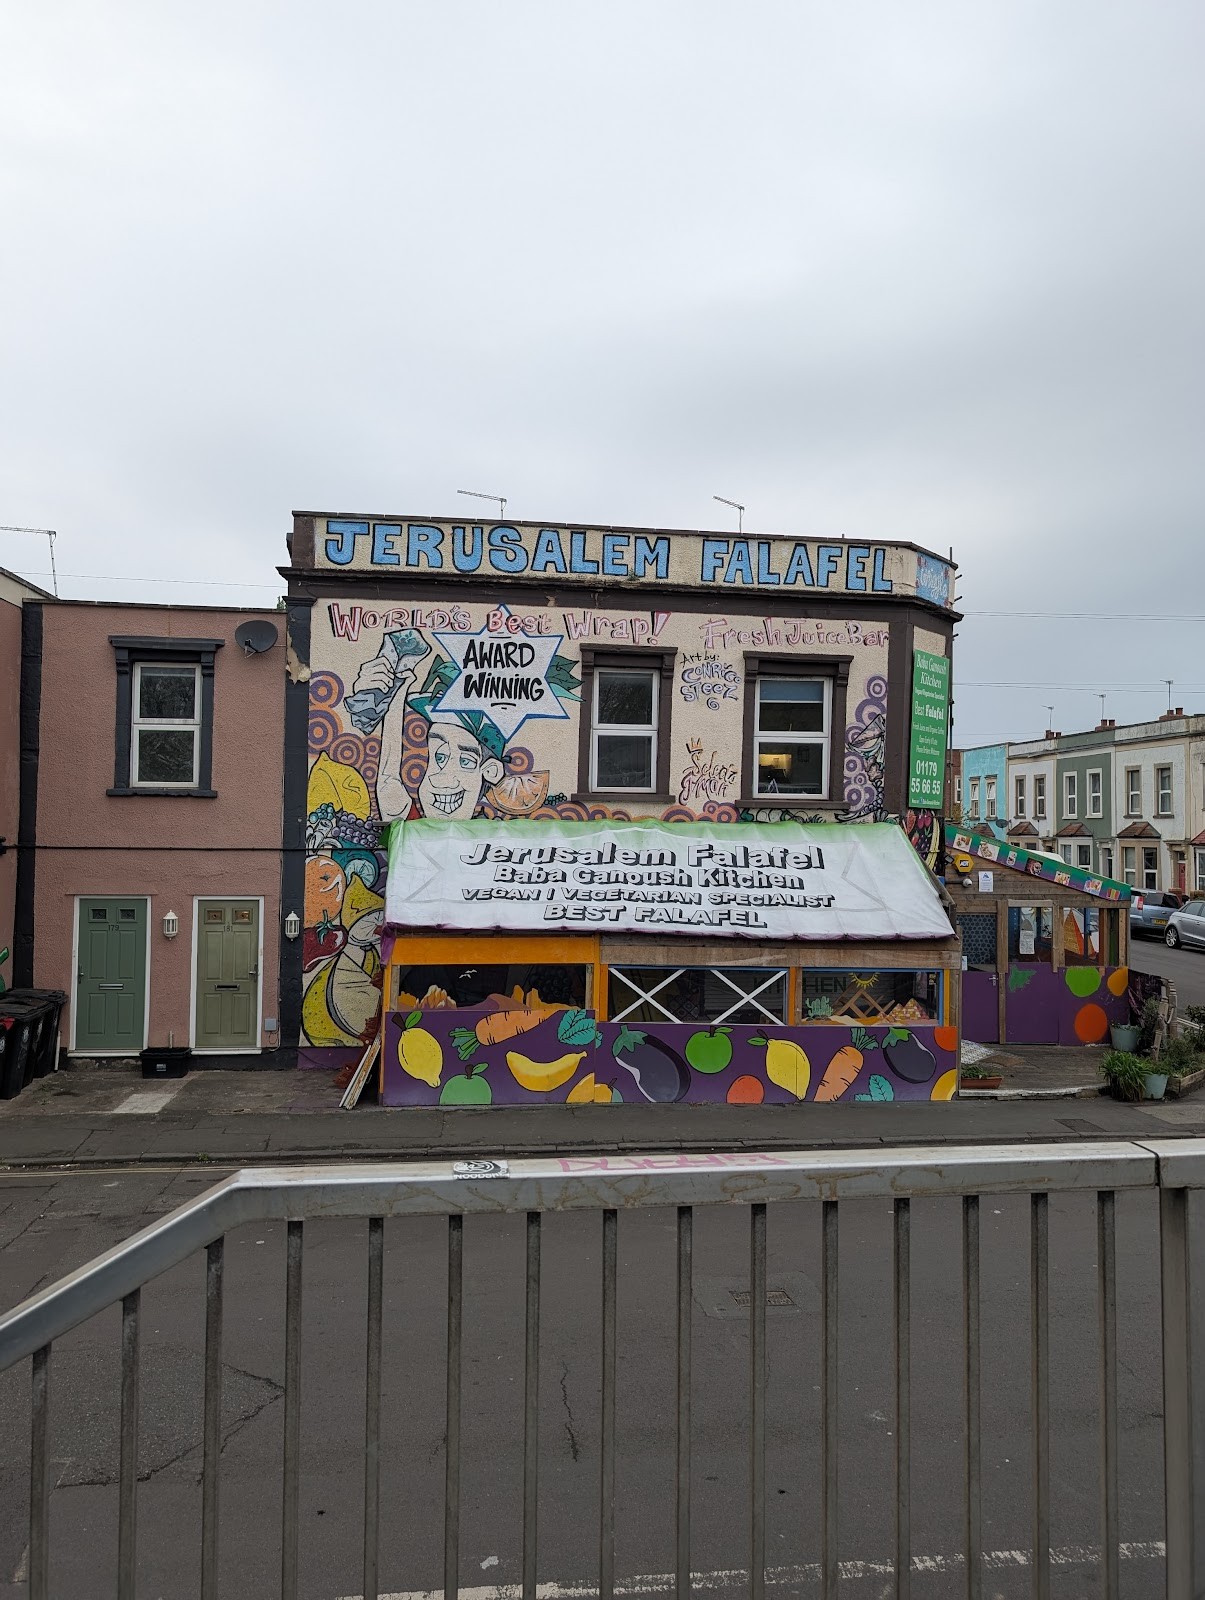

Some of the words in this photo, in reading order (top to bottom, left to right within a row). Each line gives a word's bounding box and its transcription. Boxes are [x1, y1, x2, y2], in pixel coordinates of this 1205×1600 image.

[325, 520, 671, 579] JERUSALEM
[701, 539, 893, 592] FALAFEL
[486, 609, 552, 634] Best
[563, 611, 672, 645] Wrap!
[699, 617, 782, 649] Fresh
[784, 618, 847, 646] Juice
[846, 621, 889, 648] Bar
[463, 639, 535, 669] AWARD
[680, 652, 702, 668] Art
[920, 671, 942, 689] Kitchen
[915, 701, 925, 717] Best
[925, 704, 945, 721] Falafel
[916, 759, 938, 777] 01179
[911, 778, 920, 793] 55
[922, 779, 931, 794] 66
[932, 780, 941, 795] 55
[460, 842, 677, 866] Jerusalem
[687, 843, 825, 869] Falafel
[493, 865, 566, 884] Baba
[573, 867, 692, 887] Ganoush
[698, 868, 804, 890] Kitchen
[461, 888, 542, 901] VEGAN
[561, 887, 702, 905] VEGETARIAN
[708, 891, 835, 908] SPECIALIST
[543, 904, 626, 921] BEST
[634, 906, 767, 928] FALAFEL
